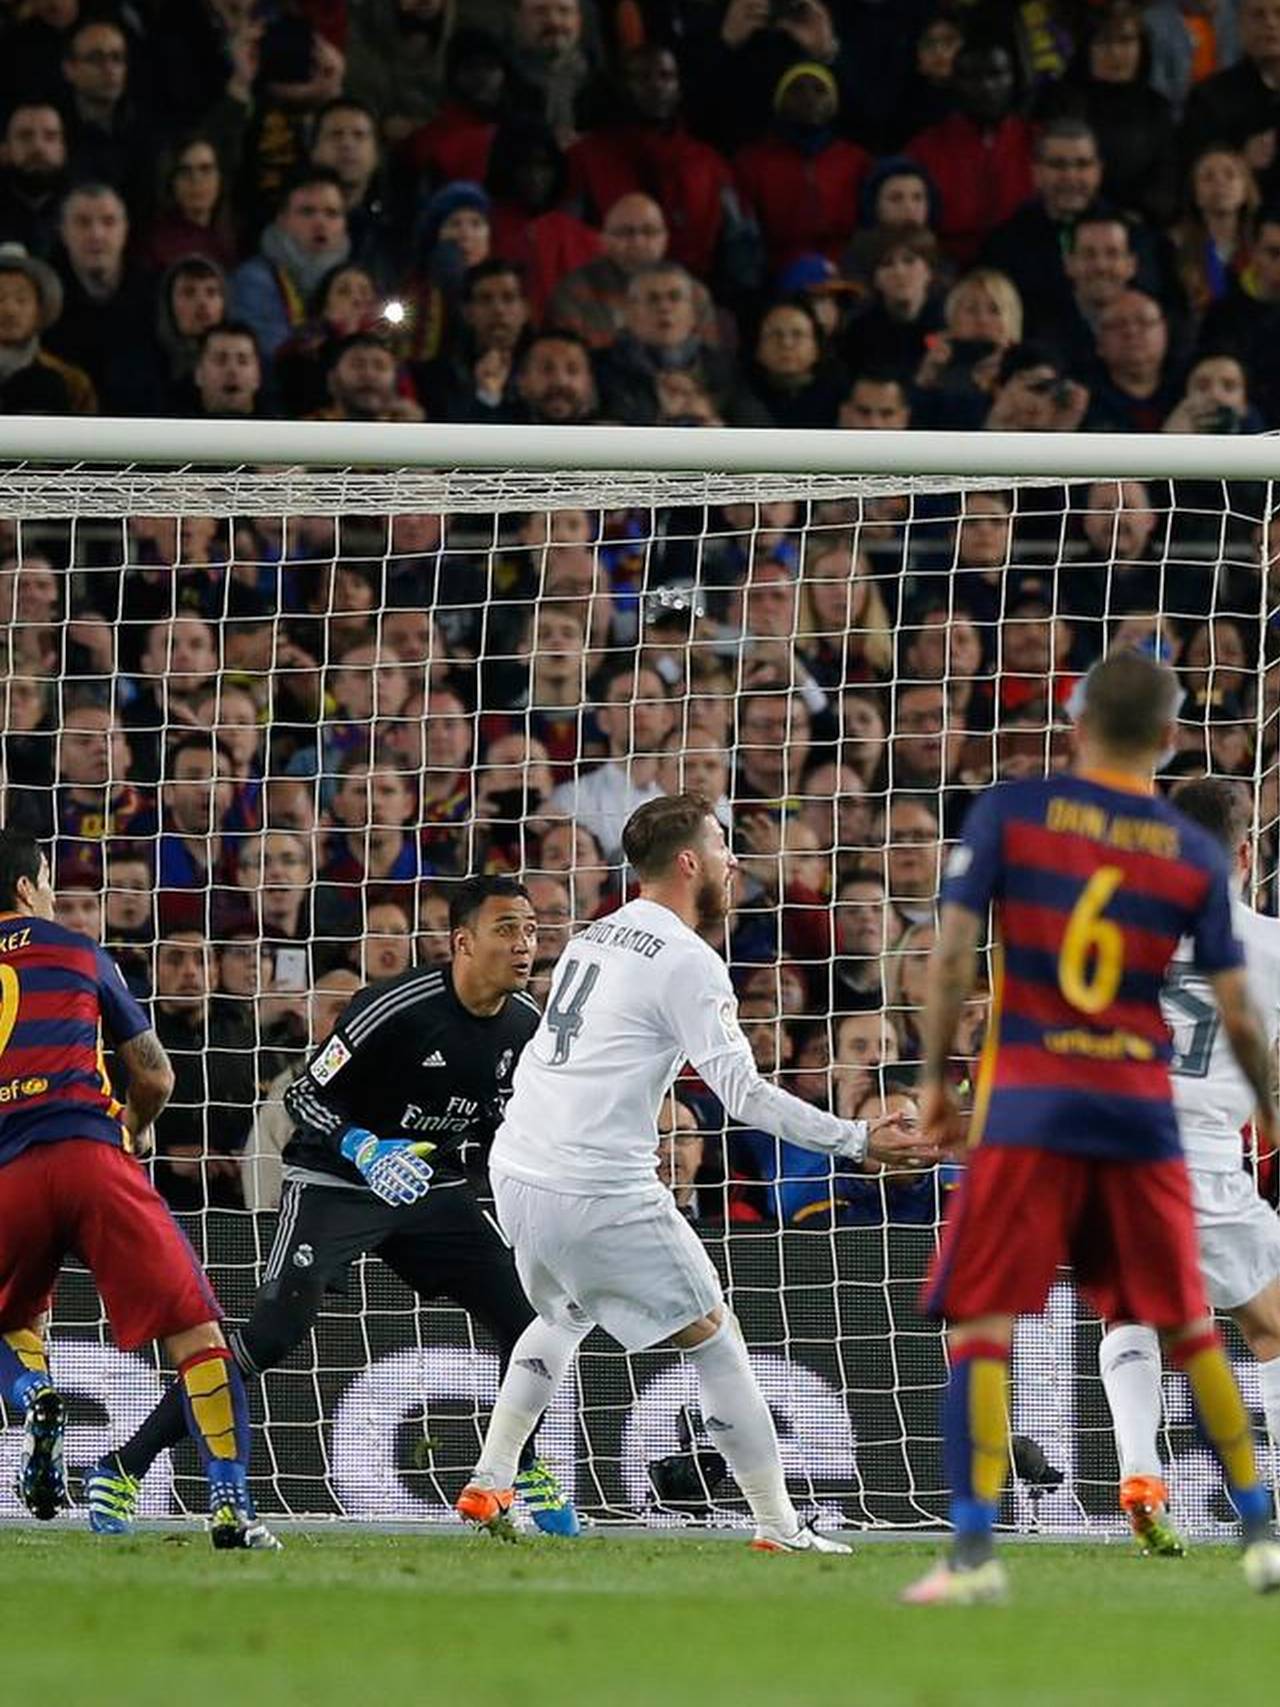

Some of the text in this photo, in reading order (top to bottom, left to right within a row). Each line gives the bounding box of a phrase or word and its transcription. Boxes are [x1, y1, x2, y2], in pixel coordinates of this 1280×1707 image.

[1058, 865, 1124, 1014] 6
[548, 958, 600, 1066] 4
[447, 1096, 478, 1116] Fly
